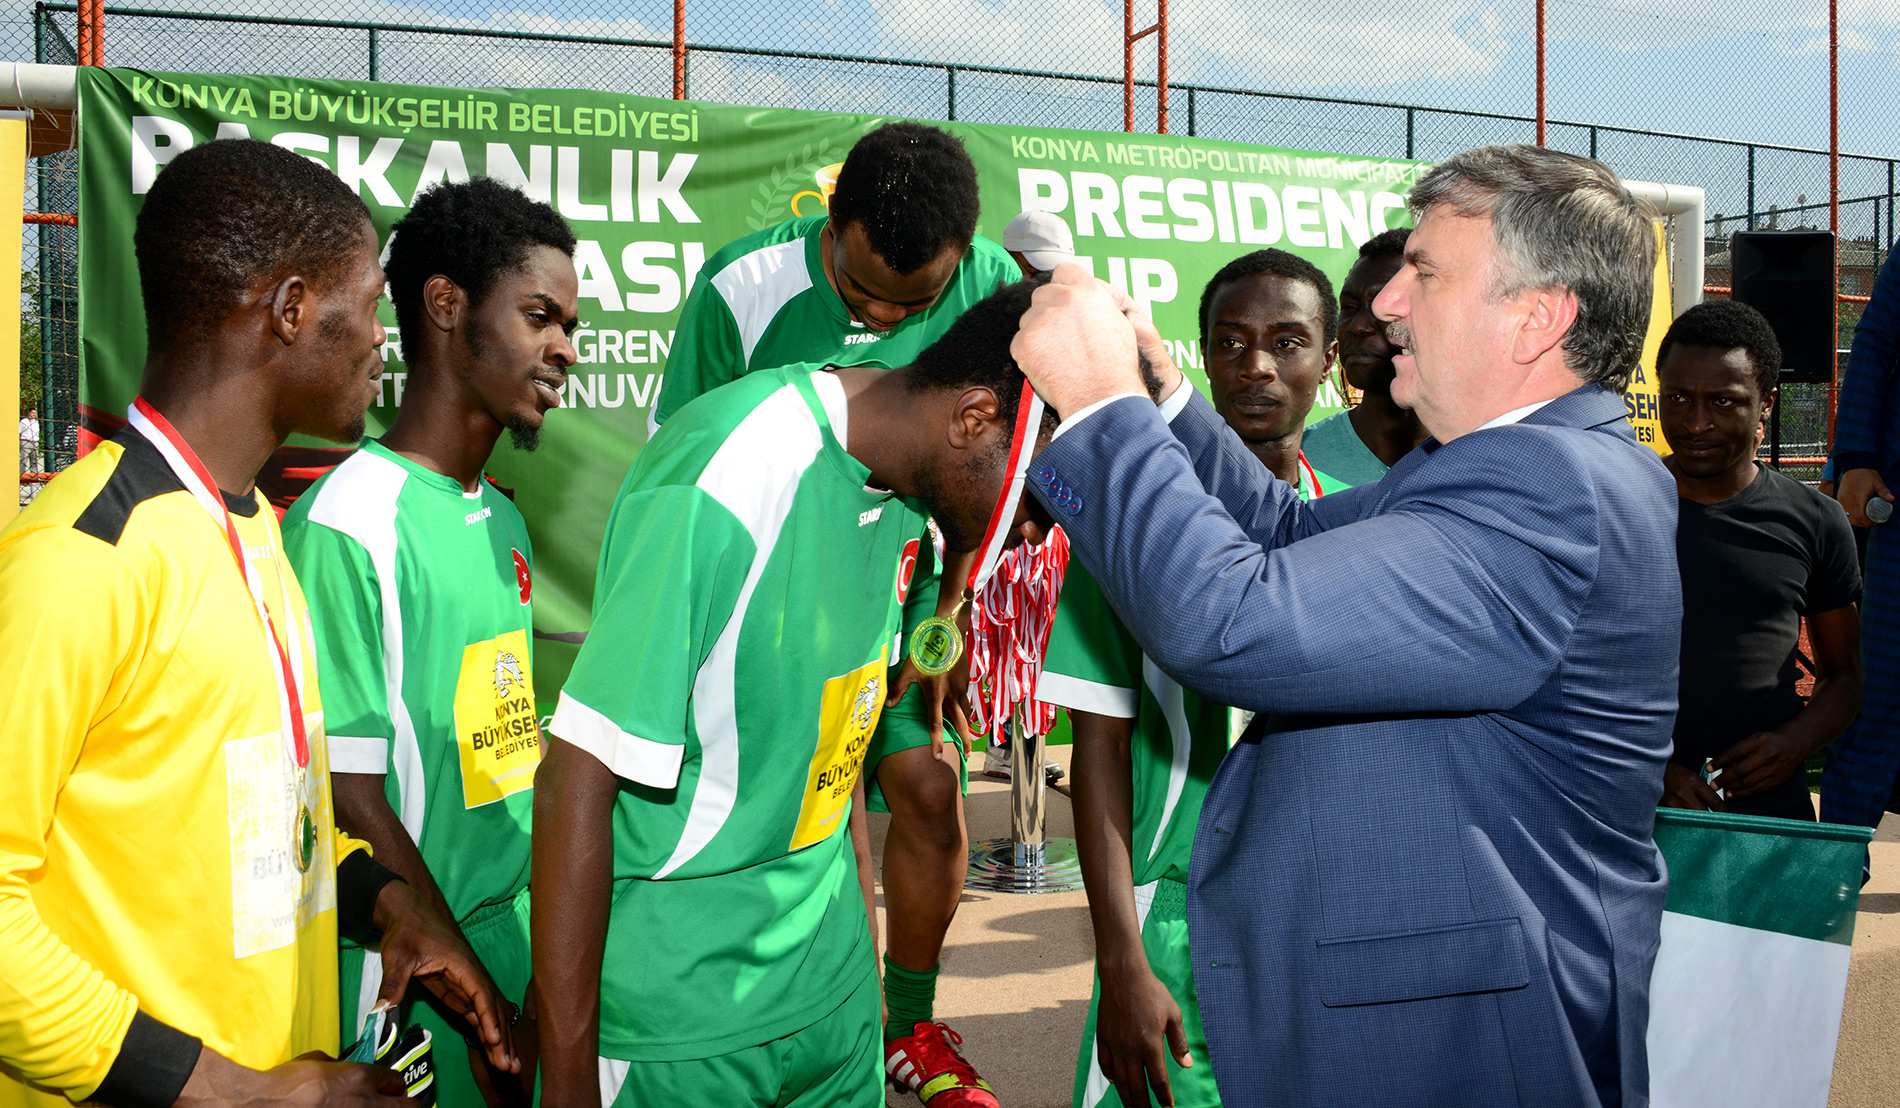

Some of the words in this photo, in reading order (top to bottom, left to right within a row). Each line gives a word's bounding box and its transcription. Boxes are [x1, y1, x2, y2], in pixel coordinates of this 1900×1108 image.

[132, 77, 257, 118] KONYA
[269, 88, 498, 133] BÜYÜKŞEHİR
[509, 102, 698, 142] BELEDİYESİ
[1011, 136, 1099, 163] KONYA
[1106, 143, 1289, 176] METROPOLITAN
[1018, 168, 1410, 249] PRESIDENC
[495, 697, 531, 721] KONYA
